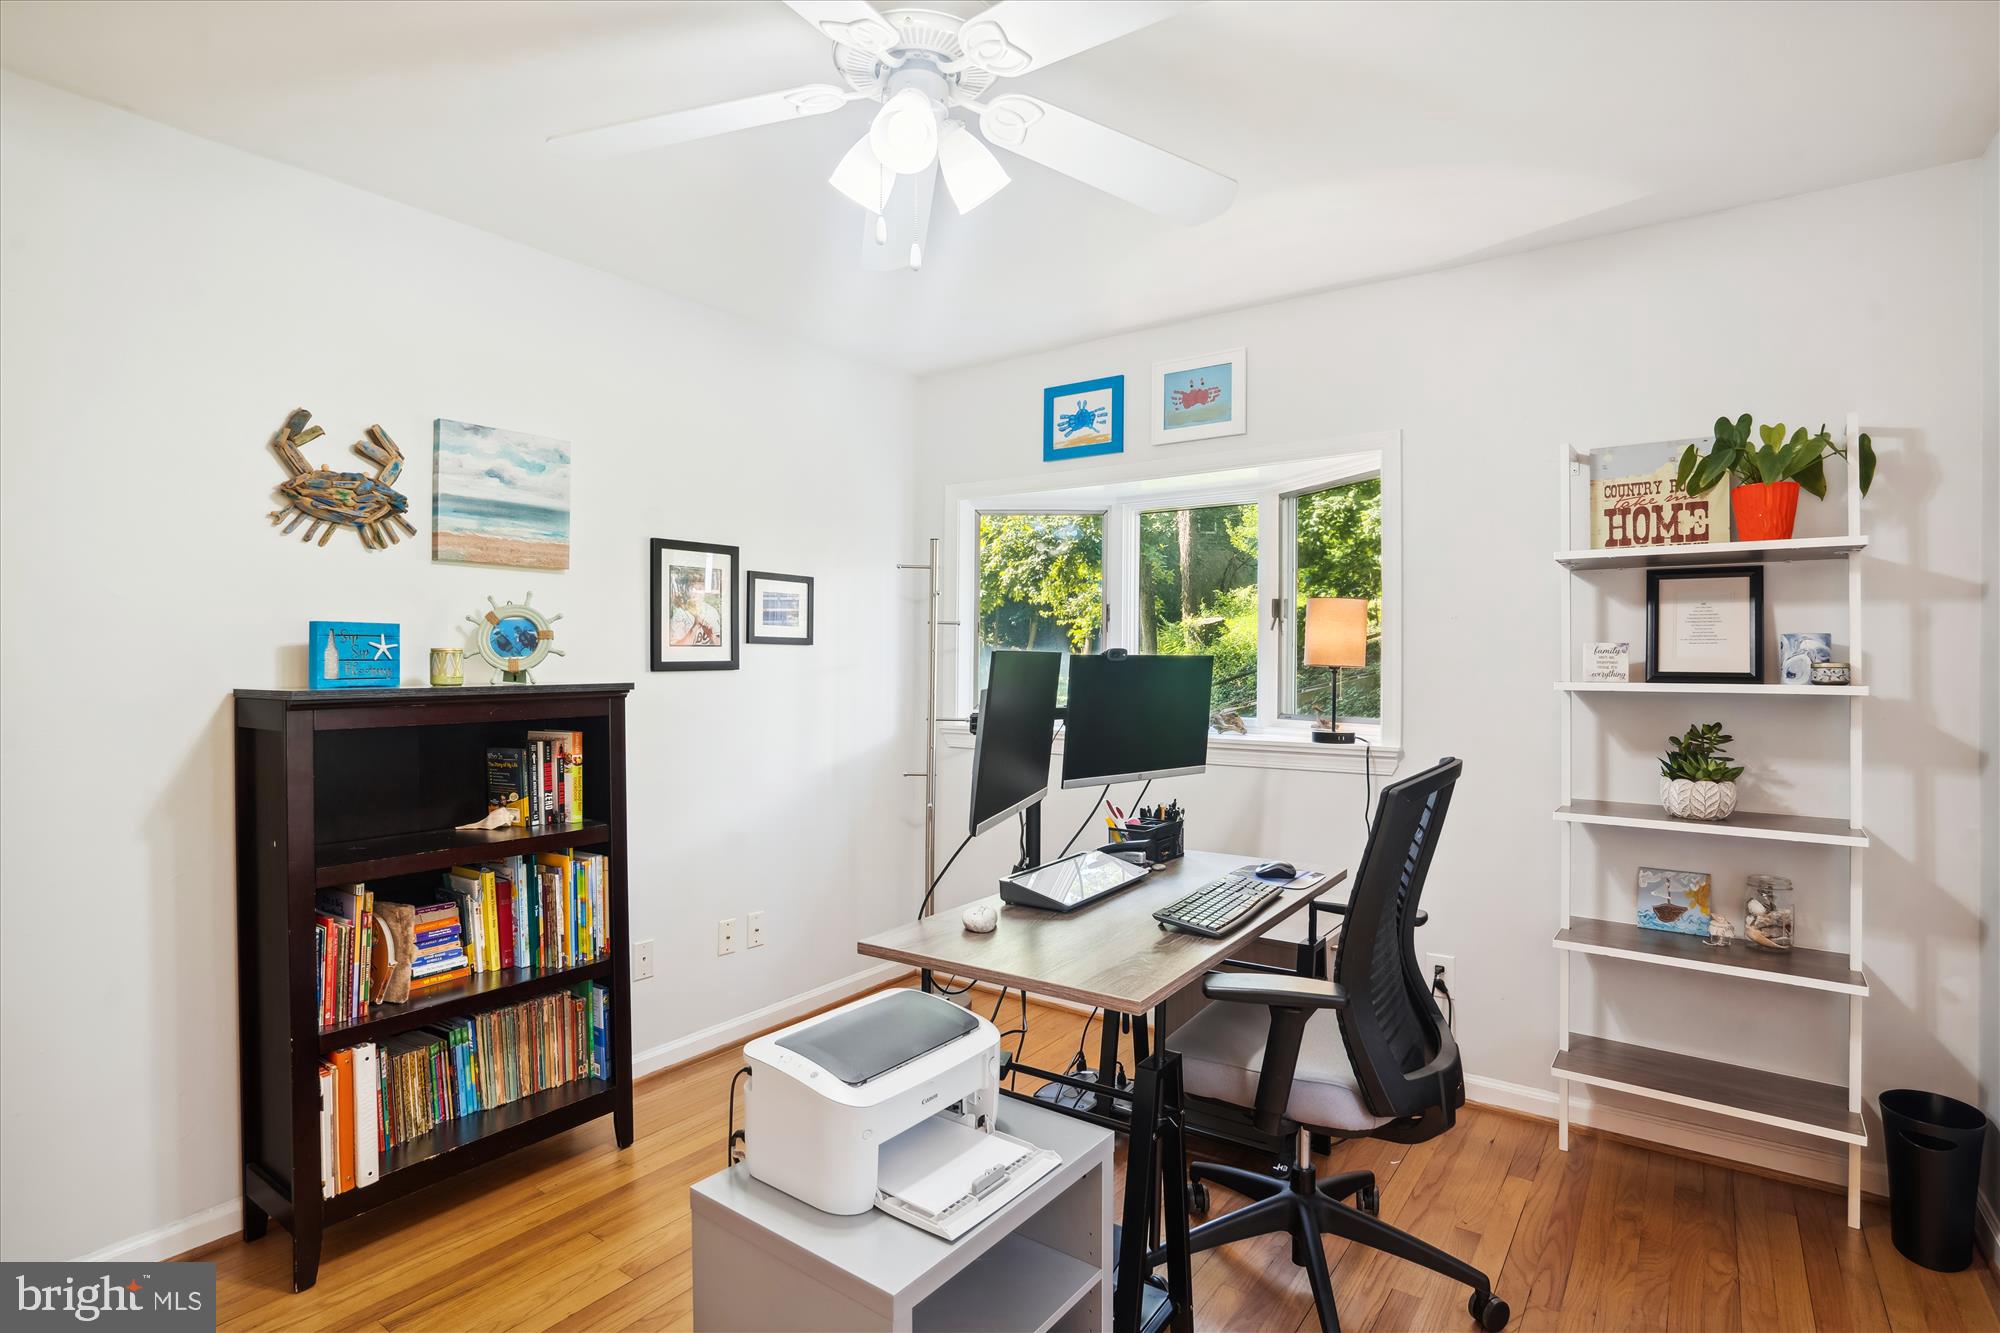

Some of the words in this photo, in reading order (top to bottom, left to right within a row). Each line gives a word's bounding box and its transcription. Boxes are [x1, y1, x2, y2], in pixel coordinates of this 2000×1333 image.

[1604, 480, 1662, 498] COUNTRY
[1614, 494, 1657, 509] take
[1604, 501, 1709, 547] HOME
[1593, 646, 1620, 656] family
[545, 792, 553, 810] ZERO
[921, 1093, 939, 1105] Canon
